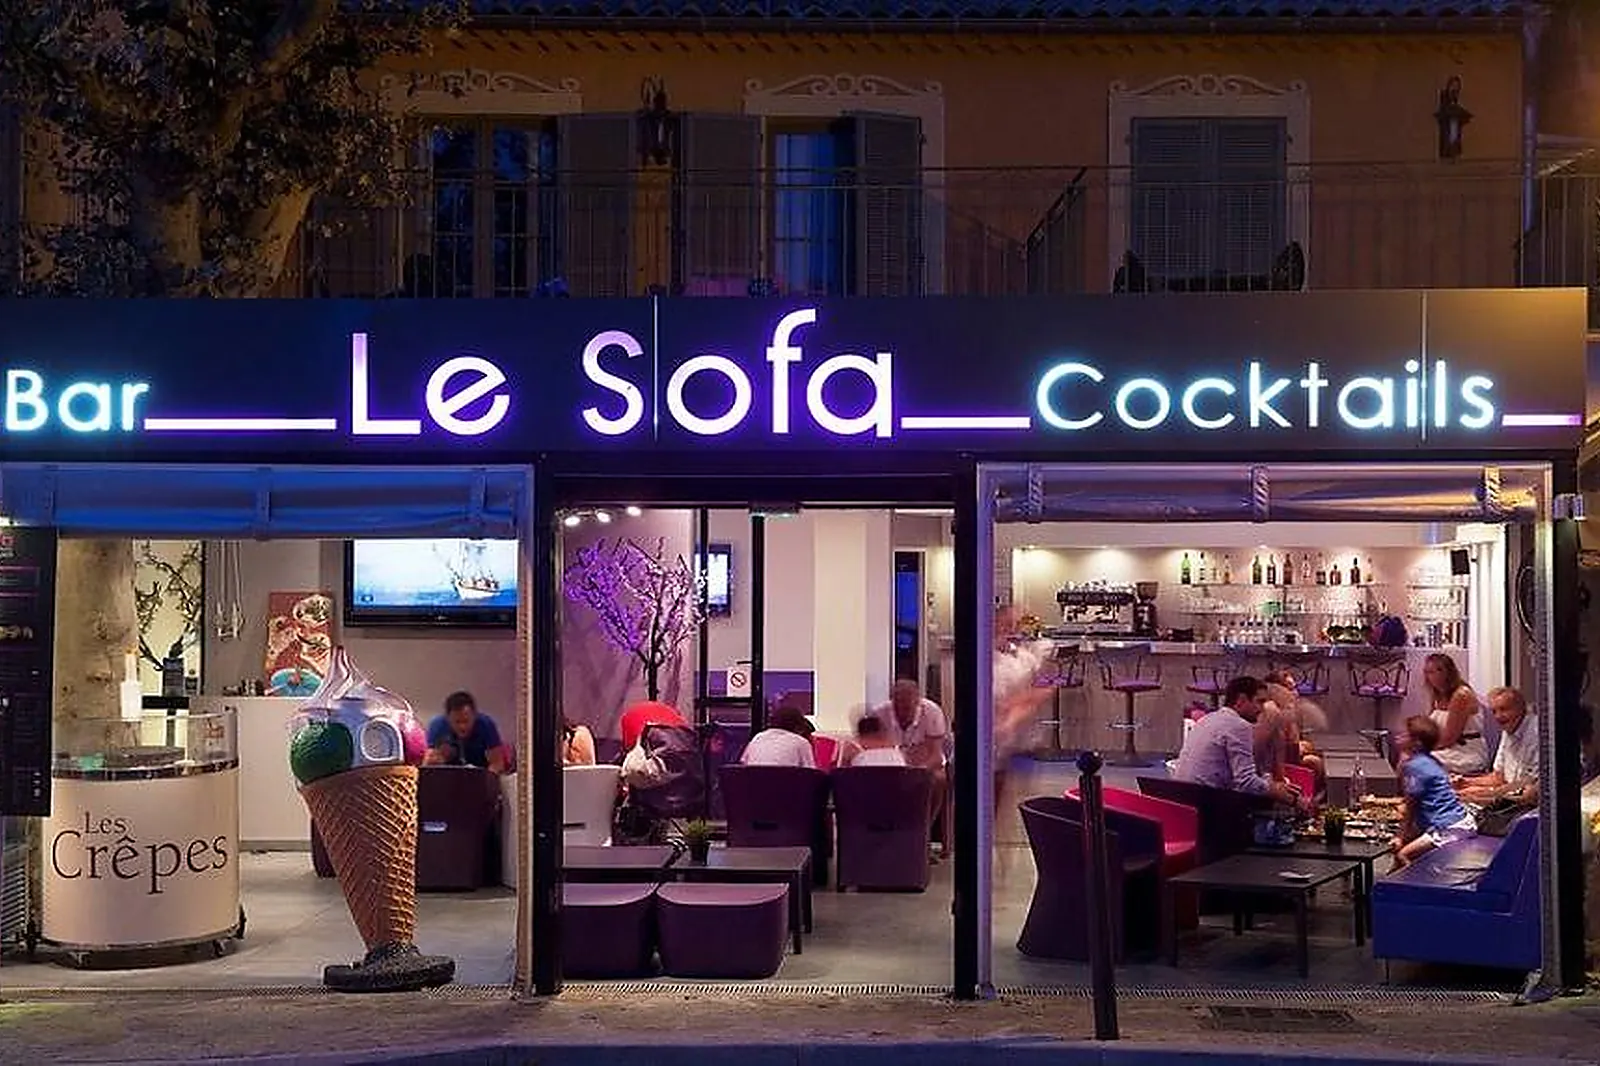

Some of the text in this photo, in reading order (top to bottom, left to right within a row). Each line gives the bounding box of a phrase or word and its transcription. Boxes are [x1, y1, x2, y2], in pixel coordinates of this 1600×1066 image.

[6, 308, 1495, 437] Bar Le Sofa Cocktails
[83, 811, 127, 835] Les
[52, 829, 228, 895] Crêpes
